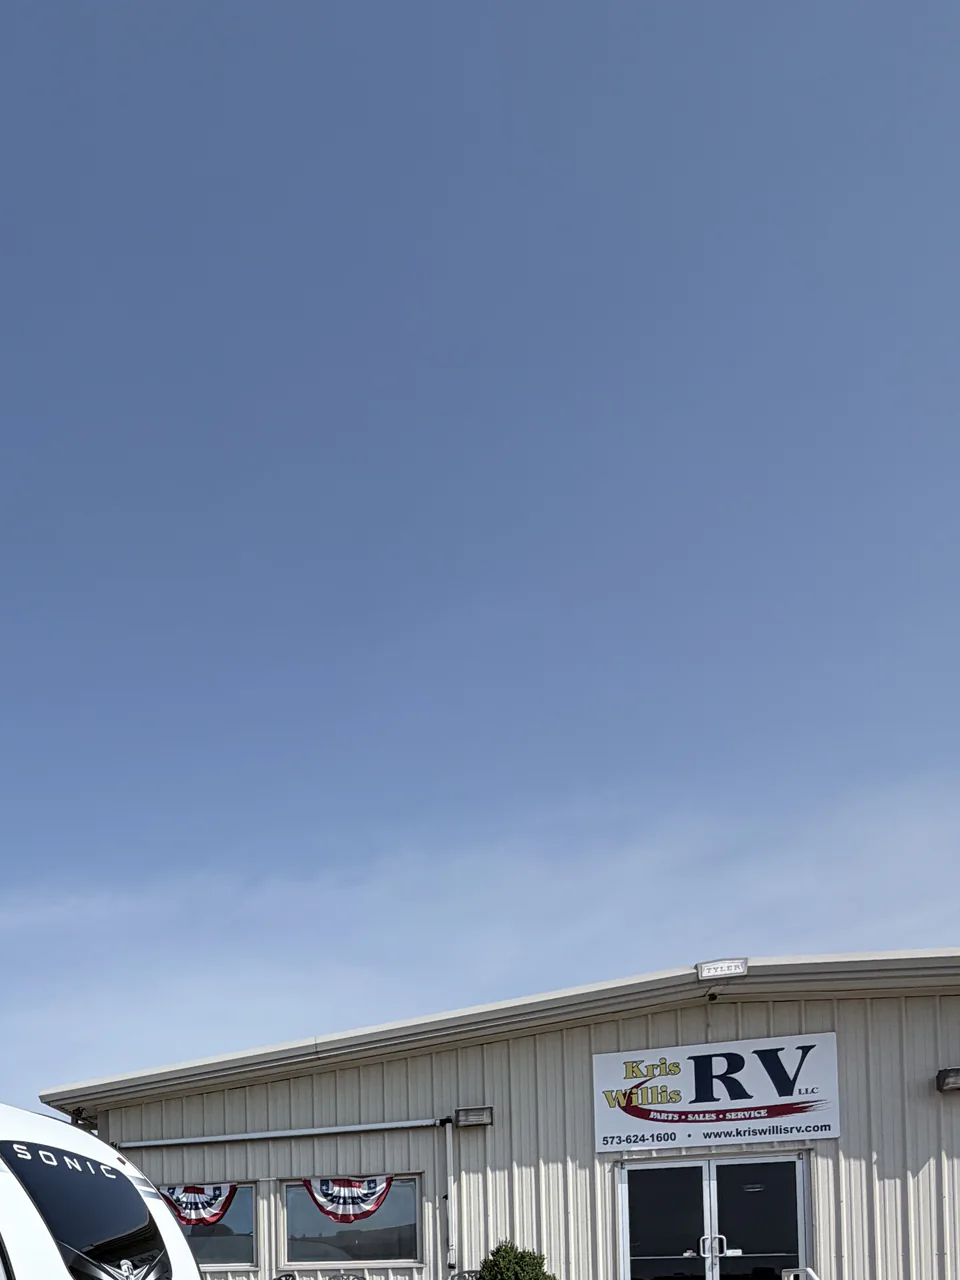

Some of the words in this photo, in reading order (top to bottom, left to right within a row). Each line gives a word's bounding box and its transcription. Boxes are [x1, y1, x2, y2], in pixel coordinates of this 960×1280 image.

[705, 964, 741, 974] TYLER
[623, 1057, 682, 1080] Kris
[686, 1044, 817, 1105] RV
[602, 1085, 683, 1109] Willis
[798, 1087, 820, 1096] LLC
[649, 1111, 679, 1121] PARTS
[687, 1112, 717, 1121] SALES
[725, 1108, 768, 1120] SERVICE
[602, 1132, 677, 1146] 573-624-1600
[702, 1123, 832, 1140] www.kriswillisrv.com
[12, 1143, 117, 1179] SONIC
